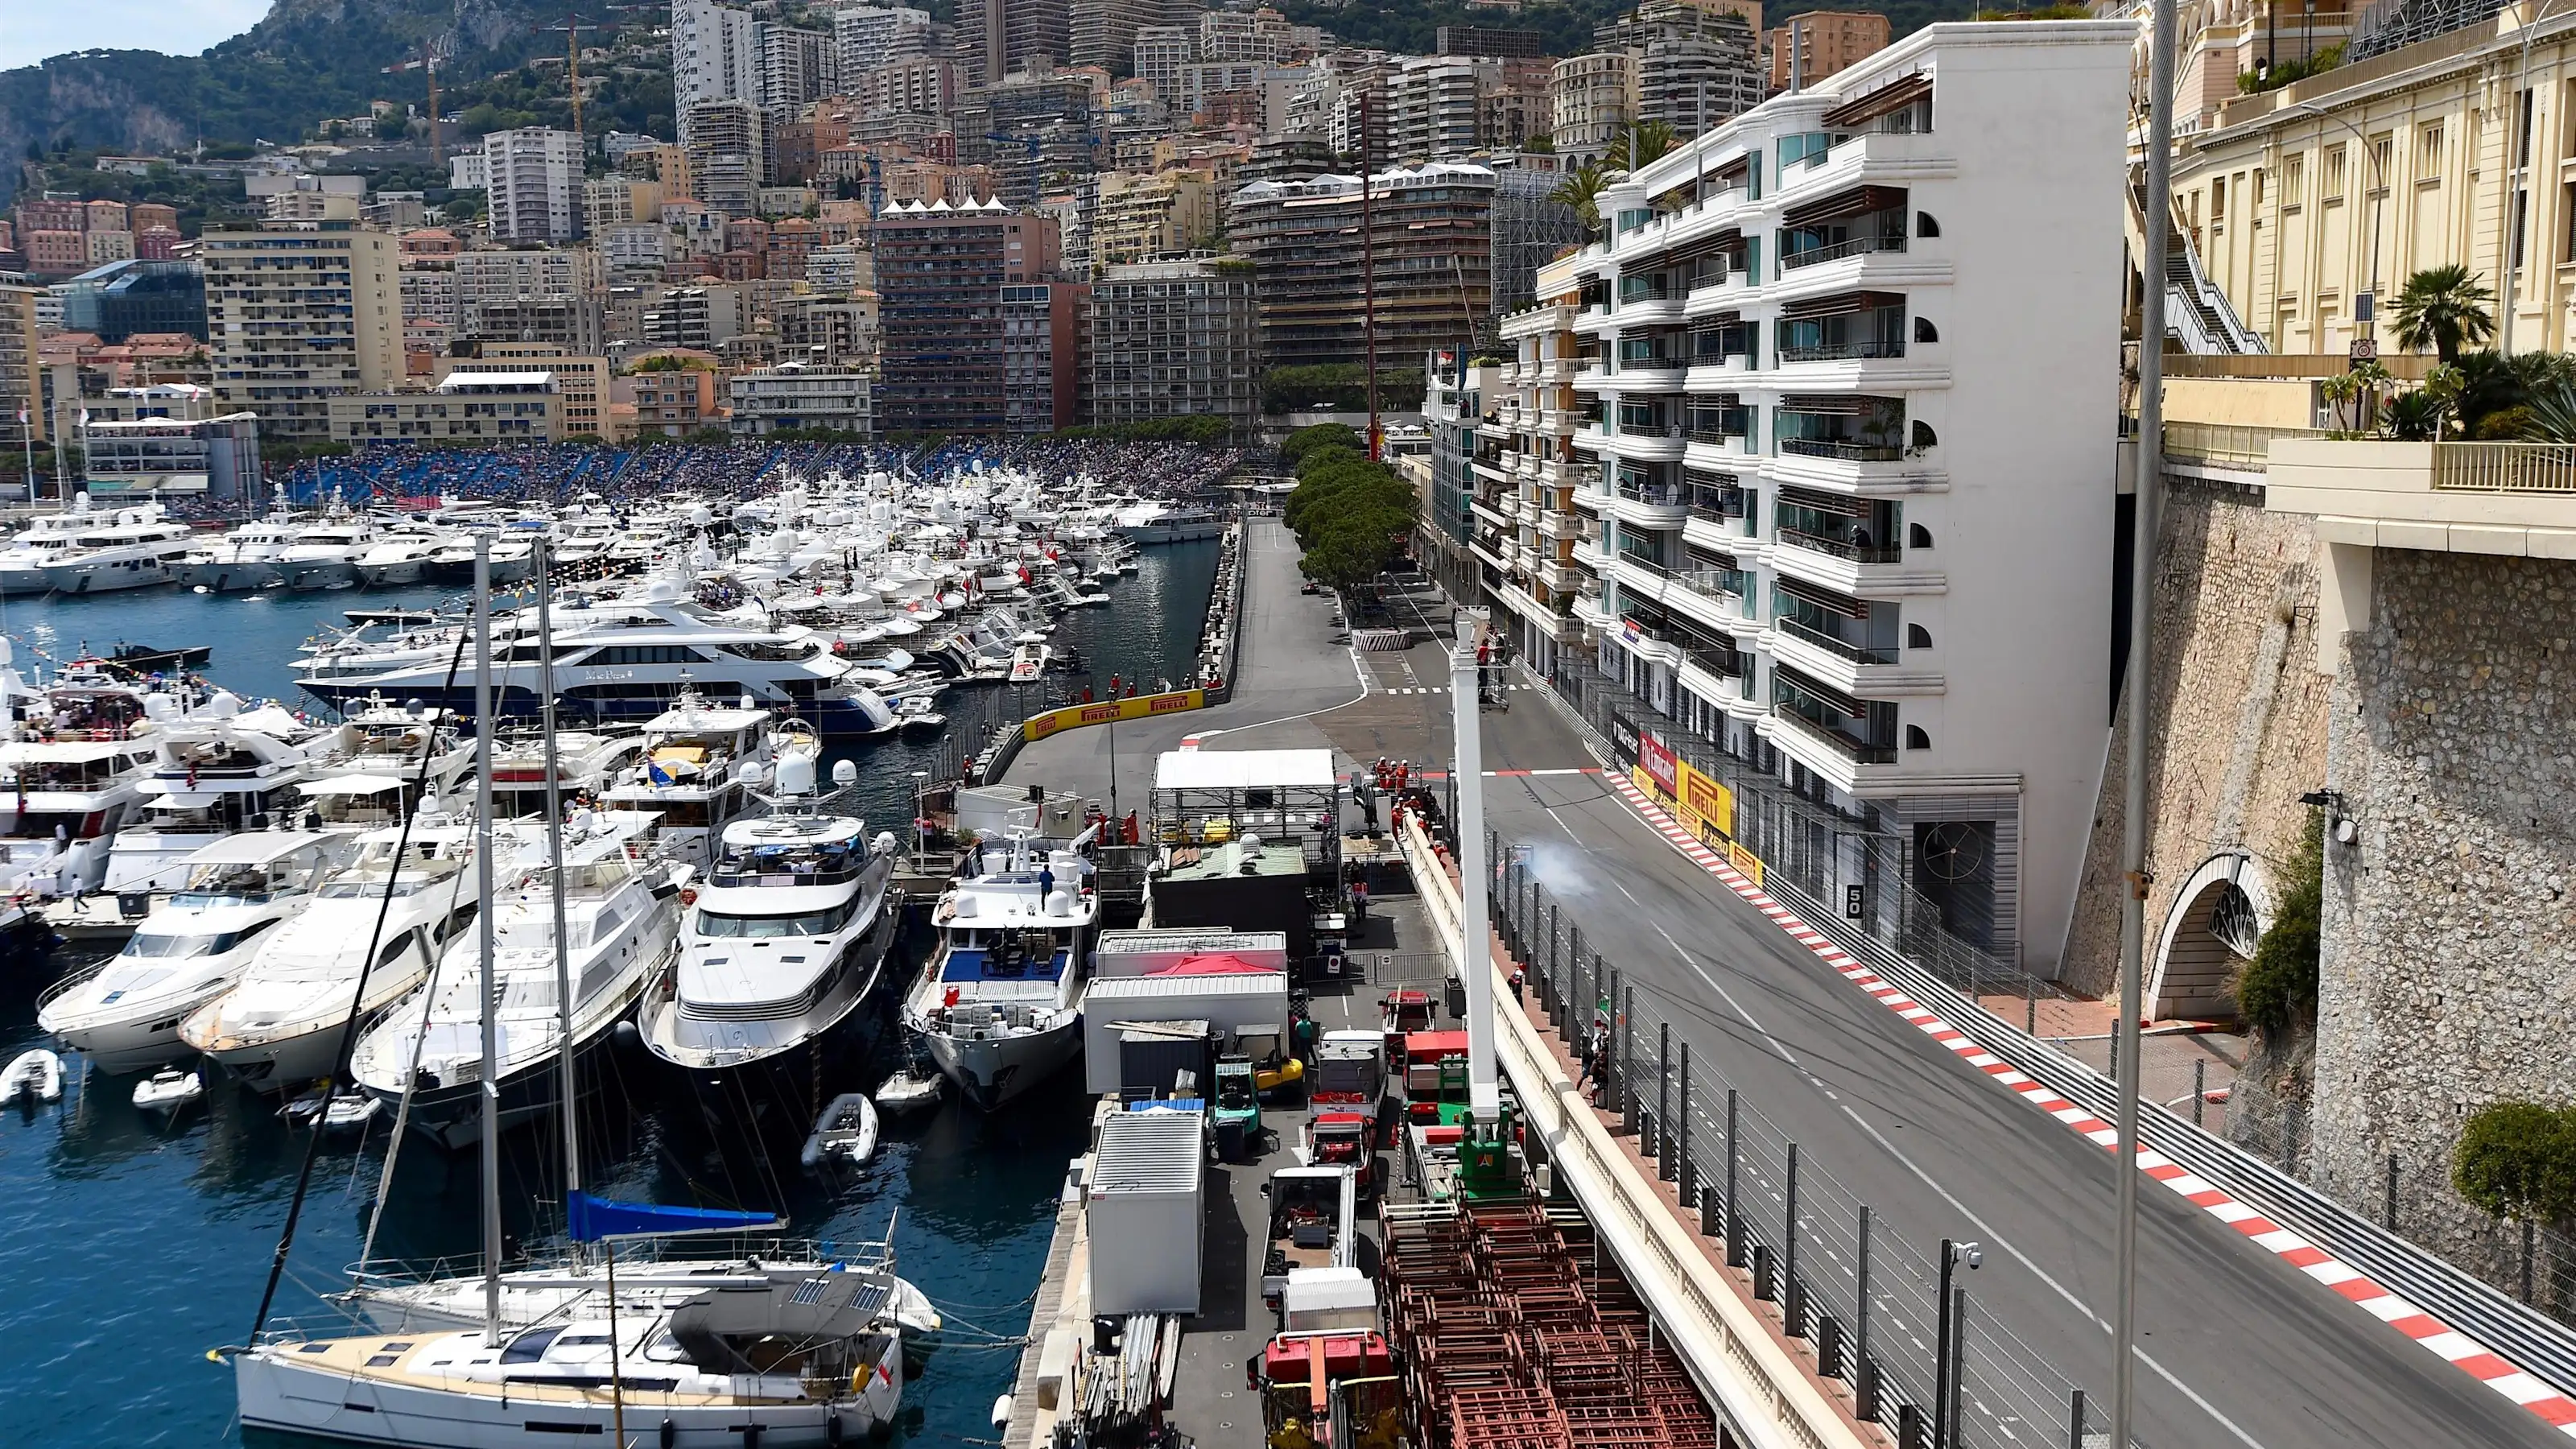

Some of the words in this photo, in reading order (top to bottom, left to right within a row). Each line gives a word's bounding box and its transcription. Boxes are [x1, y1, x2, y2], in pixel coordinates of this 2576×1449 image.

[1081, 705, 1121, 721] PIRELLI
[1150, 696, 1188, 712] PIRELLI
[1036, 716, 1055, 734] PIRELLI
[1642, 737, 1650, 772] Fly
[1651, 745, 1674, 786] Emirates
[1687, 770, 1718, 824] PIRELLI
[1849, 889, 1860, 914] 50
